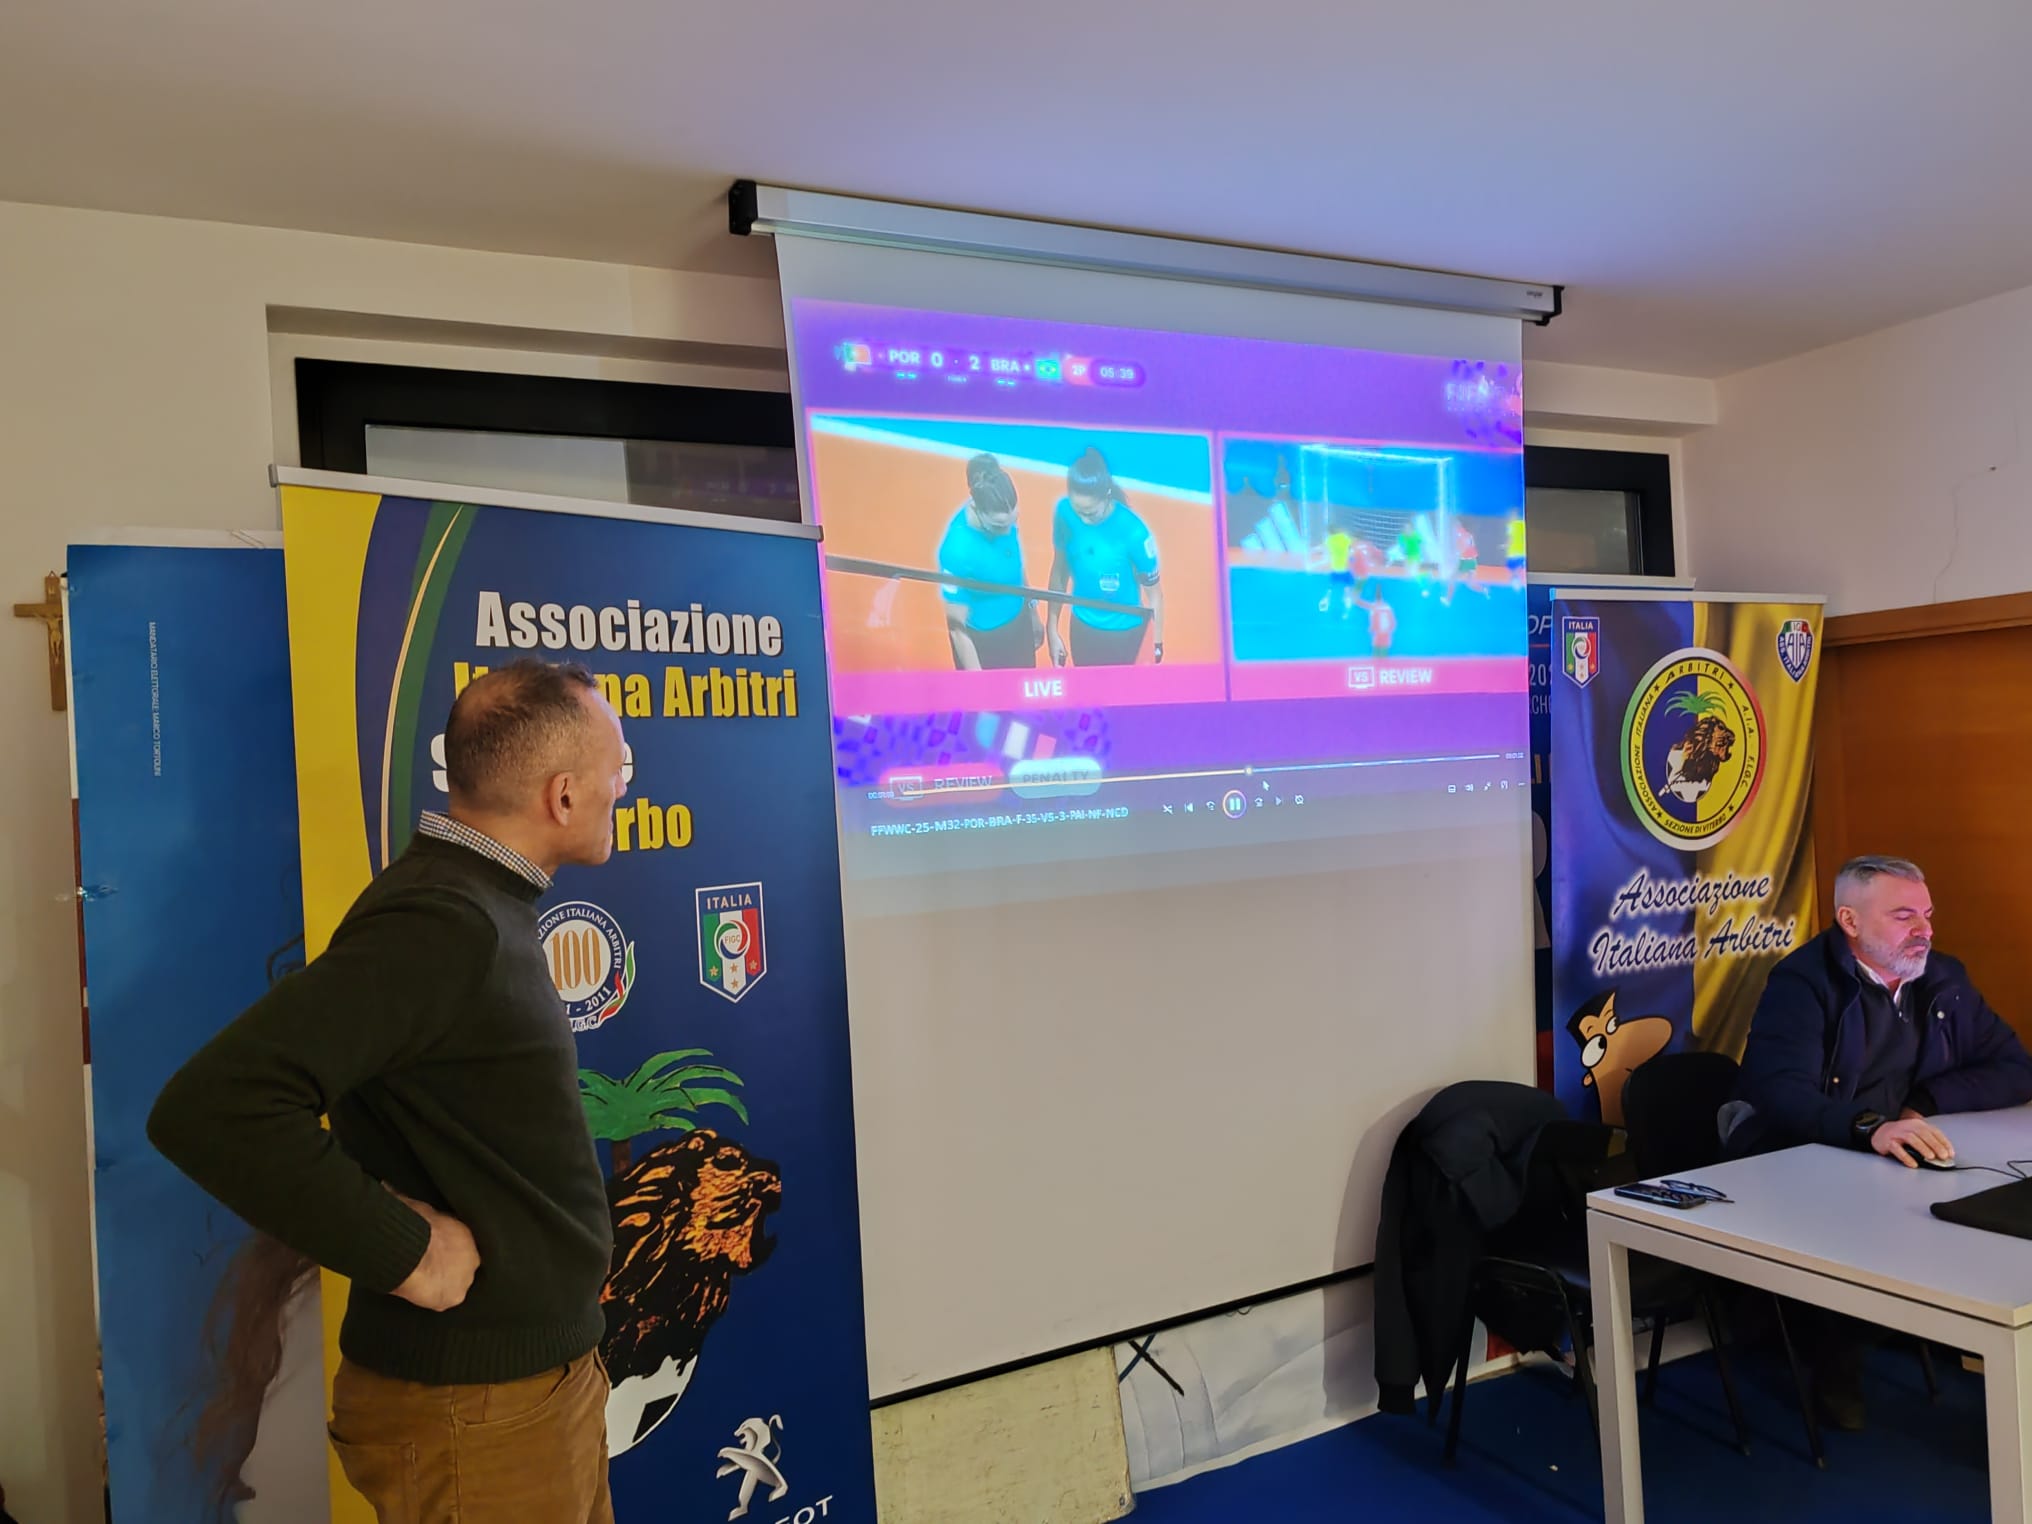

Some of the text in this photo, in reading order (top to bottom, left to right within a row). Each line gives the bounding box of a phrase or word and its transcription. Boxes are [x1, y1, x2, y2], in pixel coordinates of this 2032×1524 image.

[889, 349, 1019, 372] POR 0 2 BRA
[475, 590, 783, 657] Associazione
[1568, 621, 1594, 631] ITALIA
[1024, 680, 1063, 698] LIVE
[1380, 668, 1433, 685] REVIEW
[663, 666, 799, 718] Arbitri
[1634, 662, 1726, 812] ASSOCIAZIONE ITALIANA ARBITRI
[934, 775, 992, 791] REVIEW
[1664, 819, 1694, 834] SEZIONE
[706, 893, 752, 910] ITALIA
[1610, 871, 1771, 918] Associazione
[566, 908, 607, 929] ITALIANA
[605, 928, 622, 969] ARBITRI
[1591, 917, 1796, 973] Italiana Arbitri
[550, 927, 602, 992] 100
[585, 986, 612, 1012] 2011
